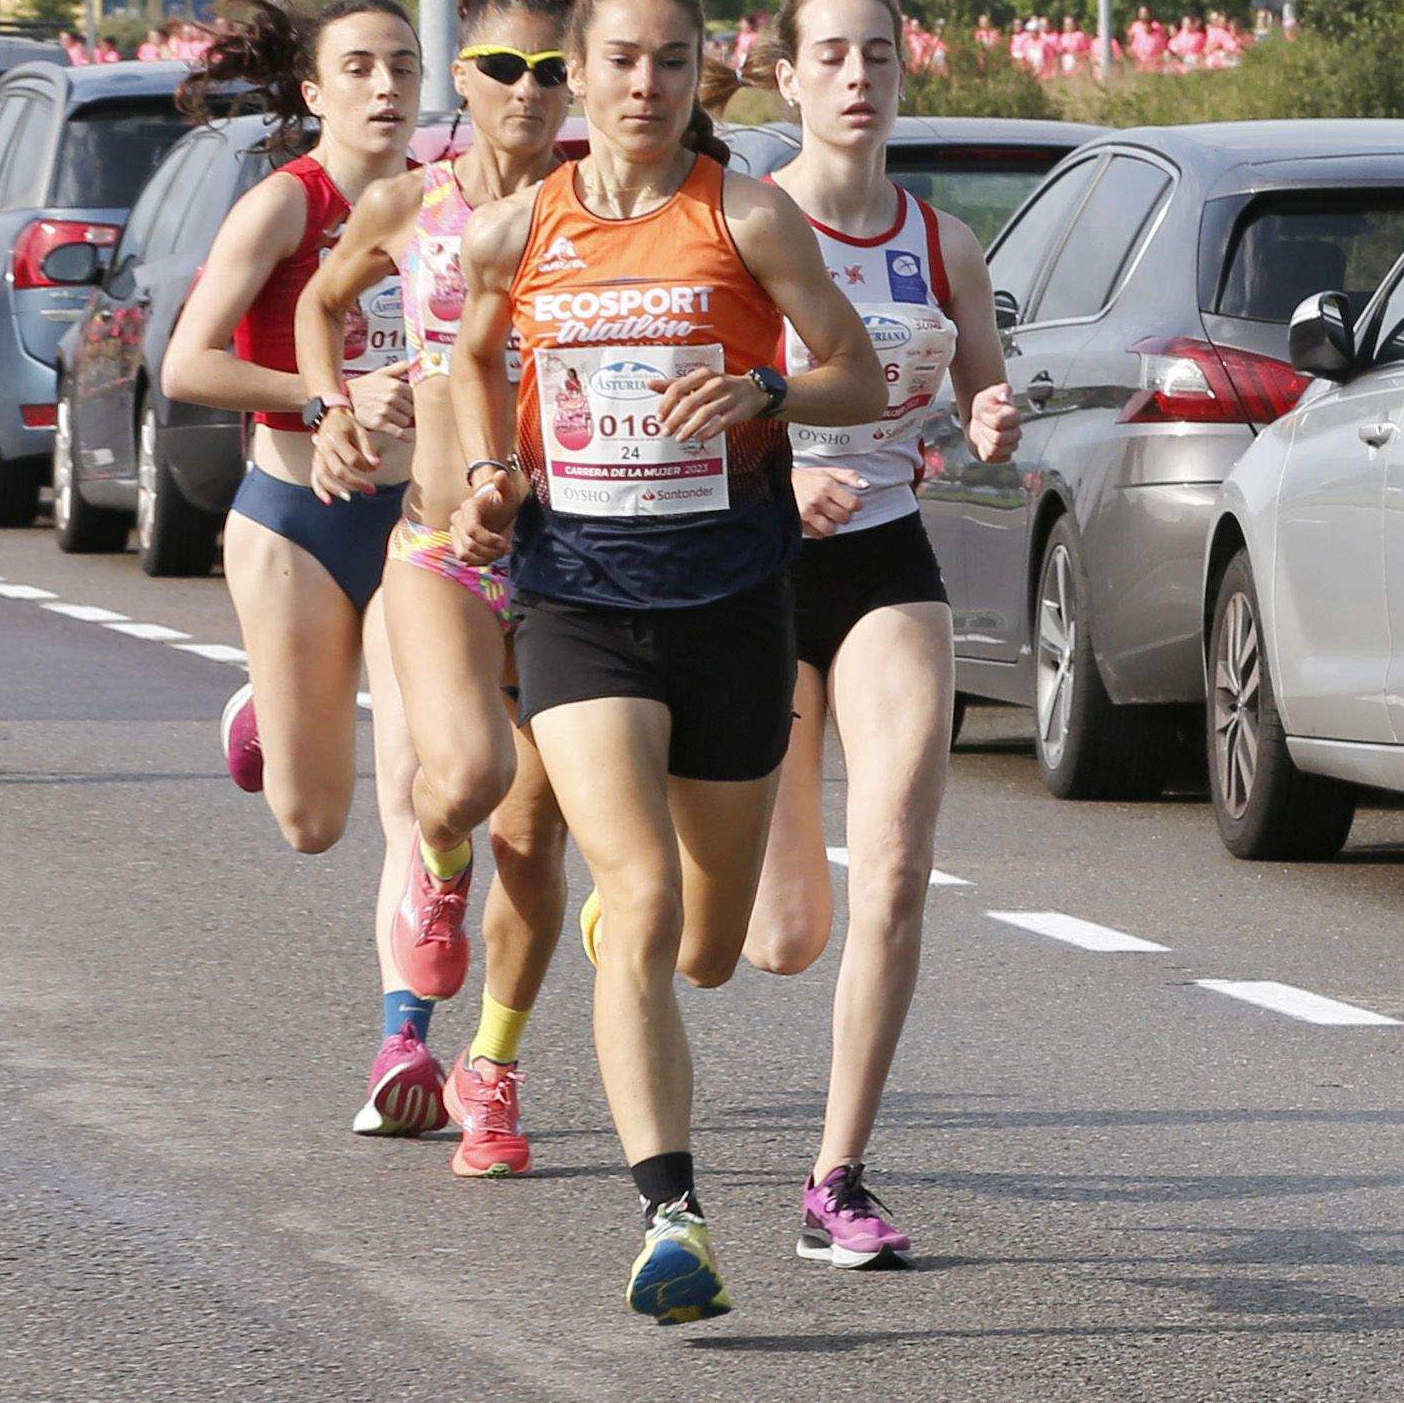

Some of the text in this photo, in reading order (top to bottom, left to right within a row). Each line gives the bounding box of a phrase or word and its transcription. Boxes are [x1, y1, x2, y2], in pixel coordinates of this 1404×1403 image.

[534, 286, 714, 322] ECOSPORT
[599, 414, 662, 437] 016
[798, 429, 851, 445] OYSHO
[621, 446, 641, 460] 24
[564, 463, 709, 478] CARRERA DE LA MUJER 2023
[564, 486, 611, 503] OYSHO
[658, 486, 714, 501] Santander
